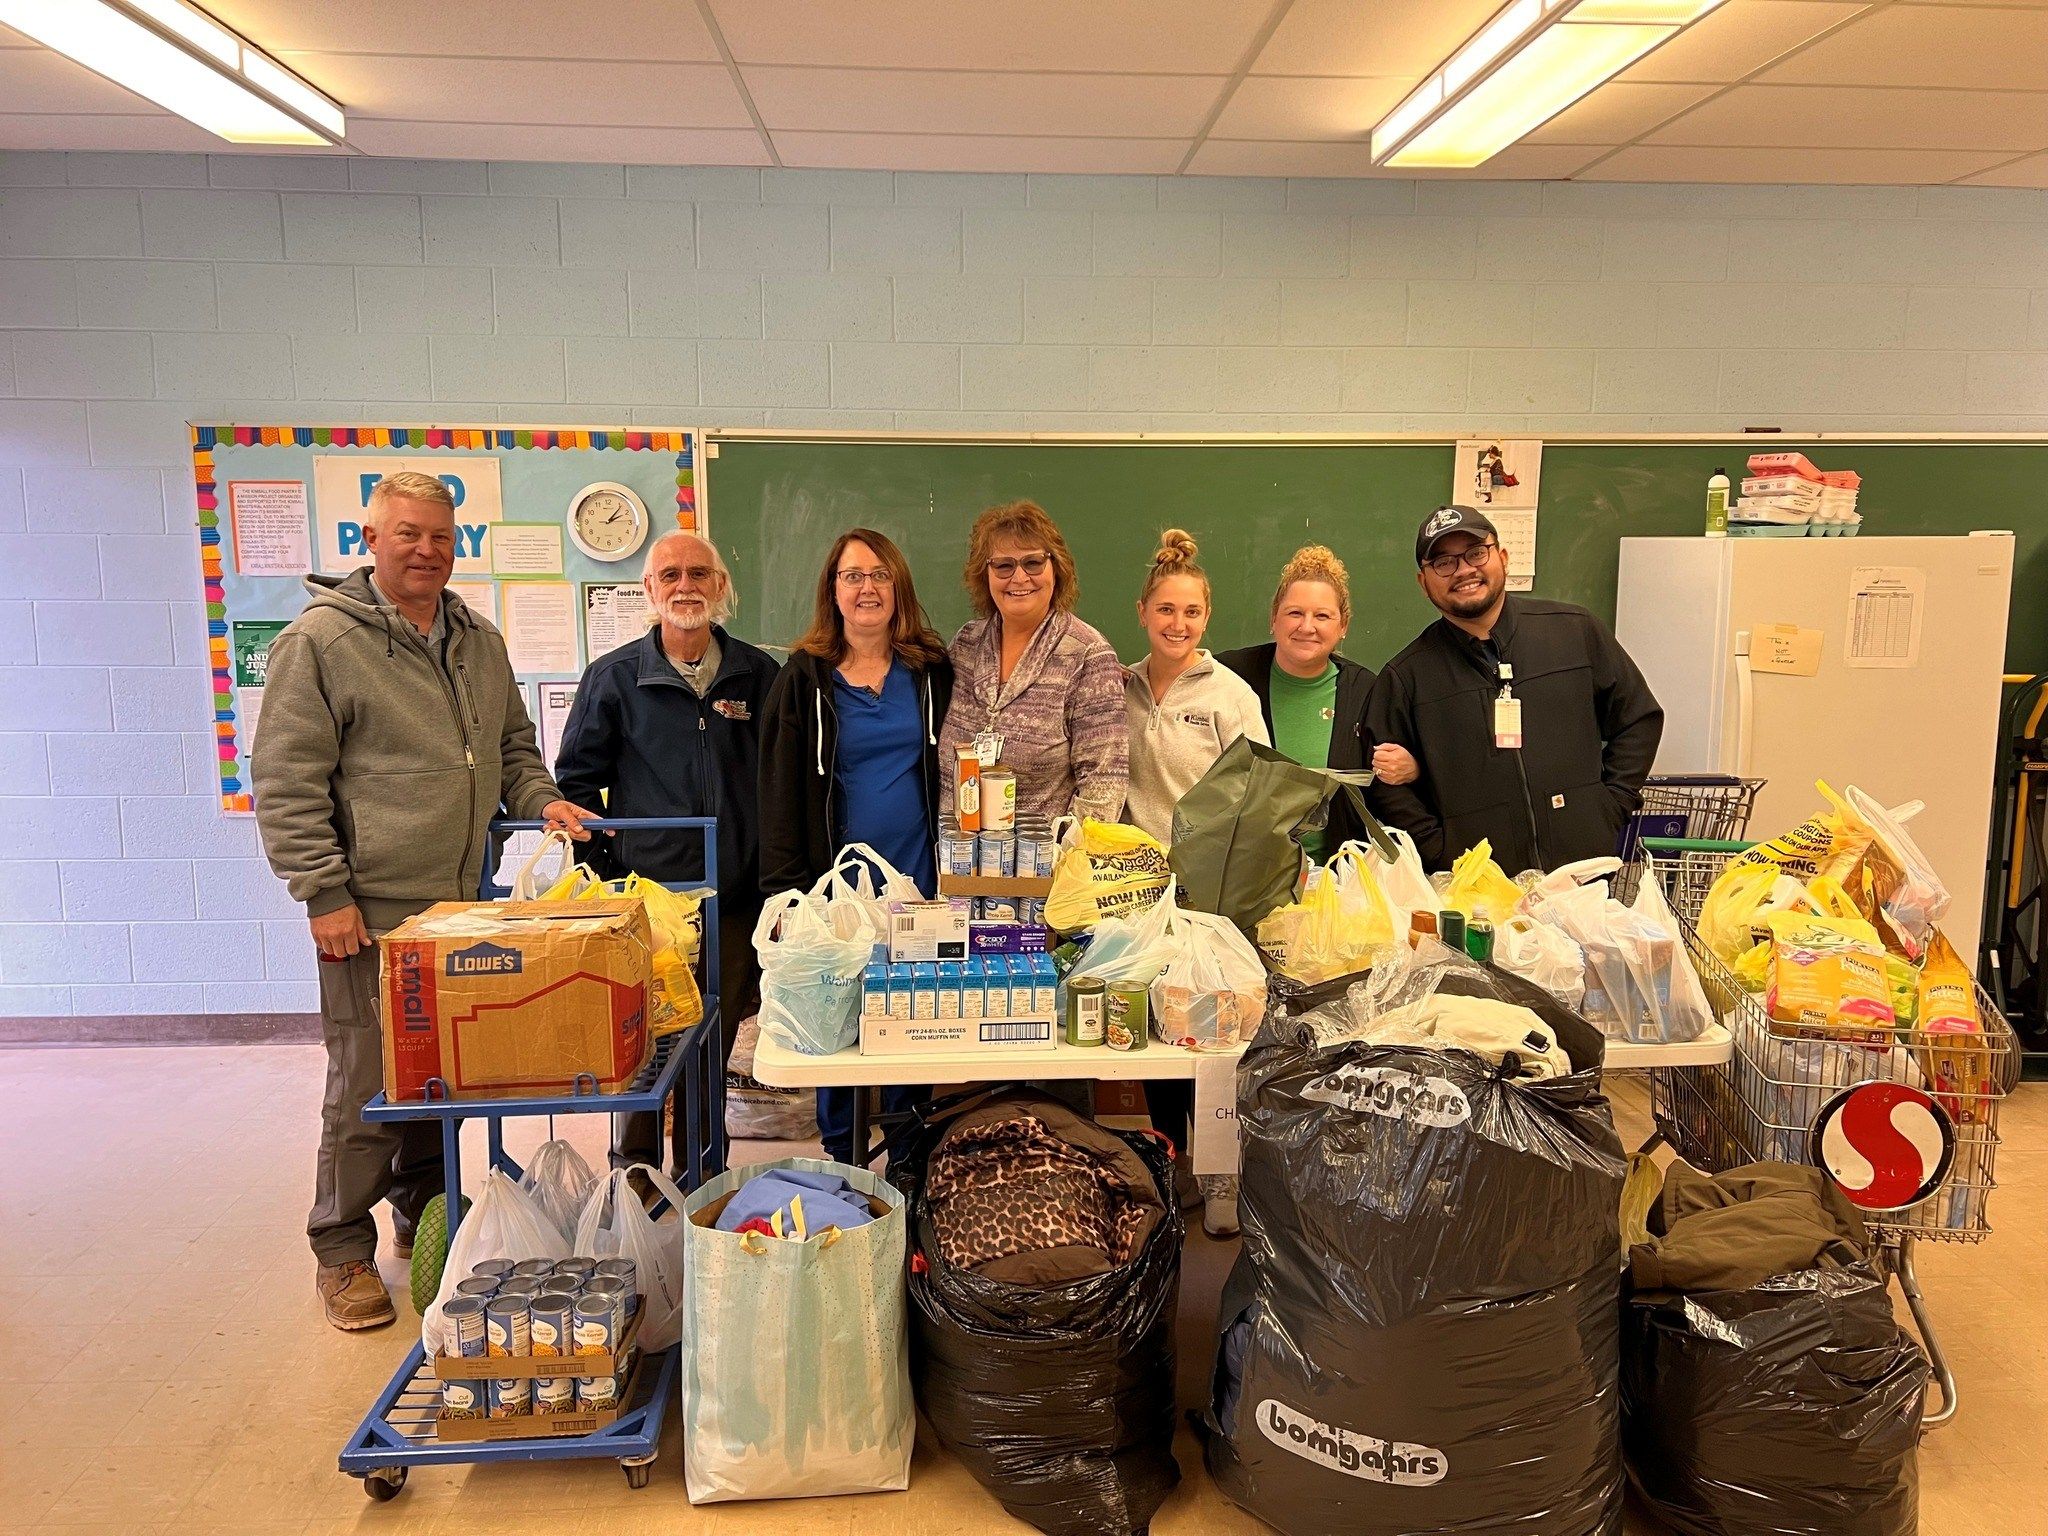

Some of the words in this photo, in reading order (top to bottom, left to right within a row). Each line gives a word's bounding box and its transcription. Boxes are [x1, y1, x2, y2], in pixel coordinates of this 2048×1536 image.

[1793, 829, 1832, 845] COUPONS
[1796, 842, 1811, 851] OUR
[1744, 850, 1770, 864] NOW
[1096, 892, 1134, 909] NOW
[1101, 910, 1114, 919] FIND
[1114, 905, 1131, 916] YOUR
[454, 954, 514, 972] LOWE'S
[402, 951, 431, 1031] small
[1930, 985, 1964, 993] PURINA
[1215, 1108, 1238, 1119] CH
